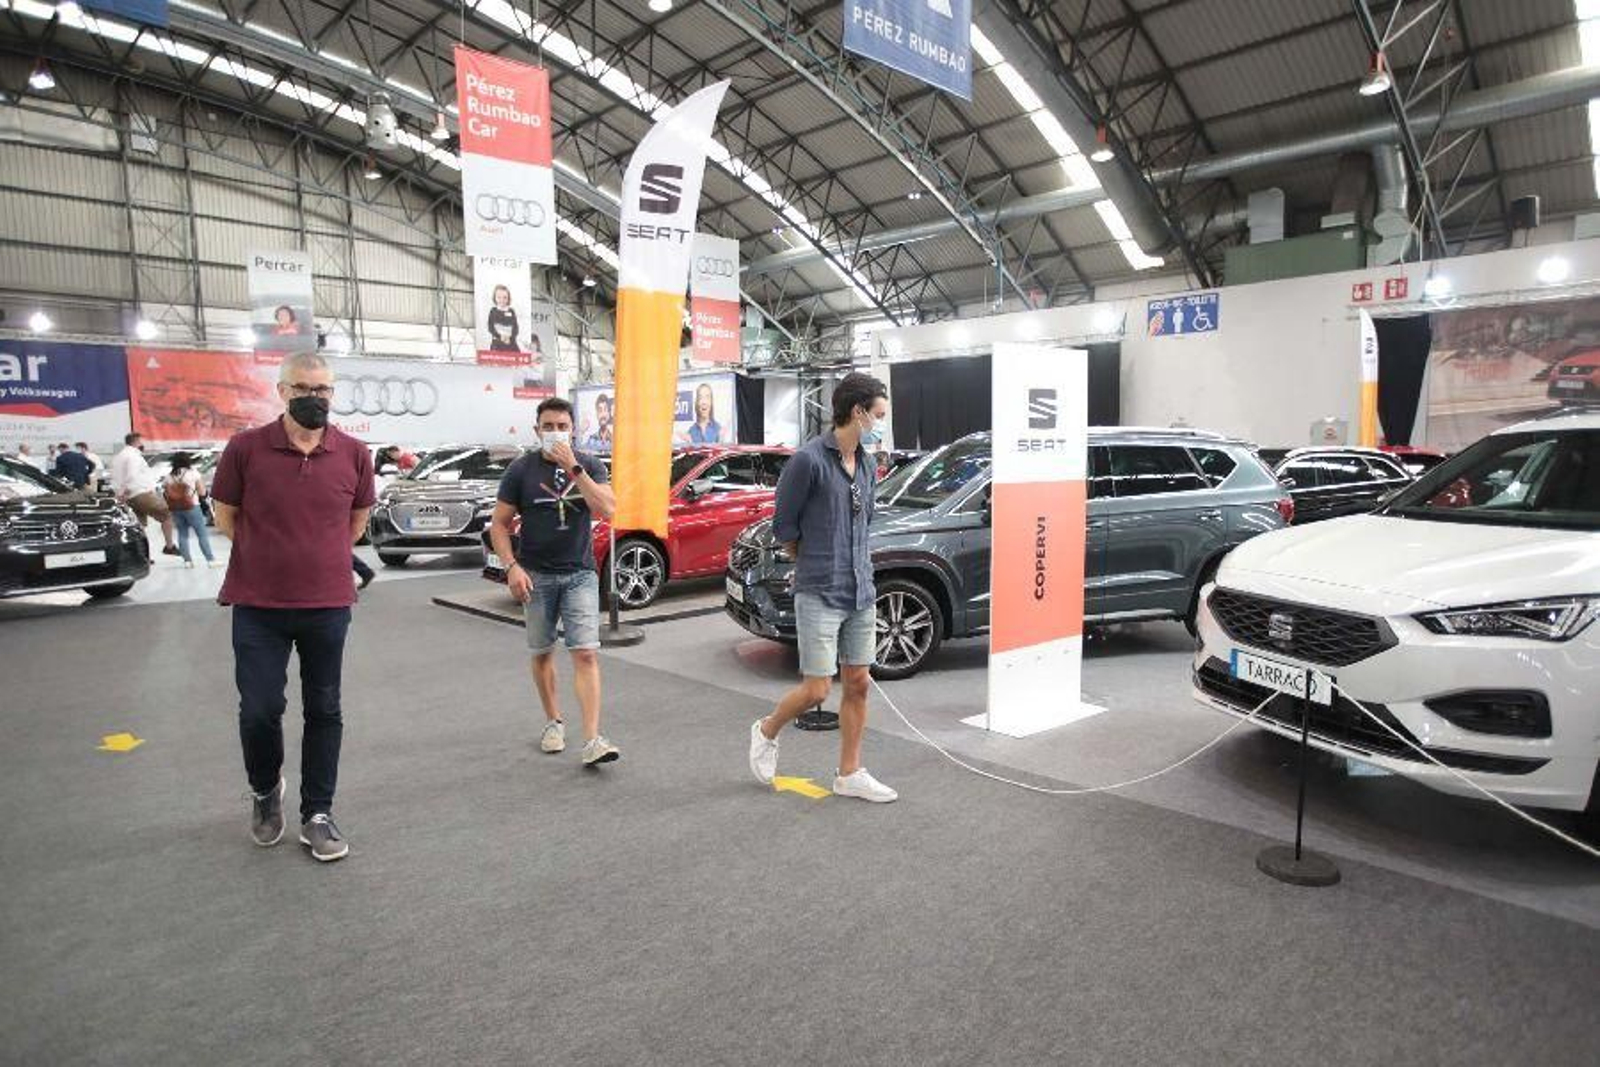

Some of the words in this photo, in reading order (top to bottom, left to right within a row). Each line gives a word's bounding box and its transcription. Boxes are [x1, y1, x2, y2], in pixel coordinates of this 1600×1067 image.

[853, 6, 903, 44] PÉREZ
[909, 31, 966, 72] RUMBAO
[466, 73, 516, 102] Pérez
[467, 95, 541, 127] Rumbao
[468, 118, 498, 139] Car
[627, 223, 690, 243] SEAT
[9, 387, 77, 399] Volkswagen
[1018, 439, 1067, 452] SEAT
[1034, 516, 1046, 600] COPERVI
